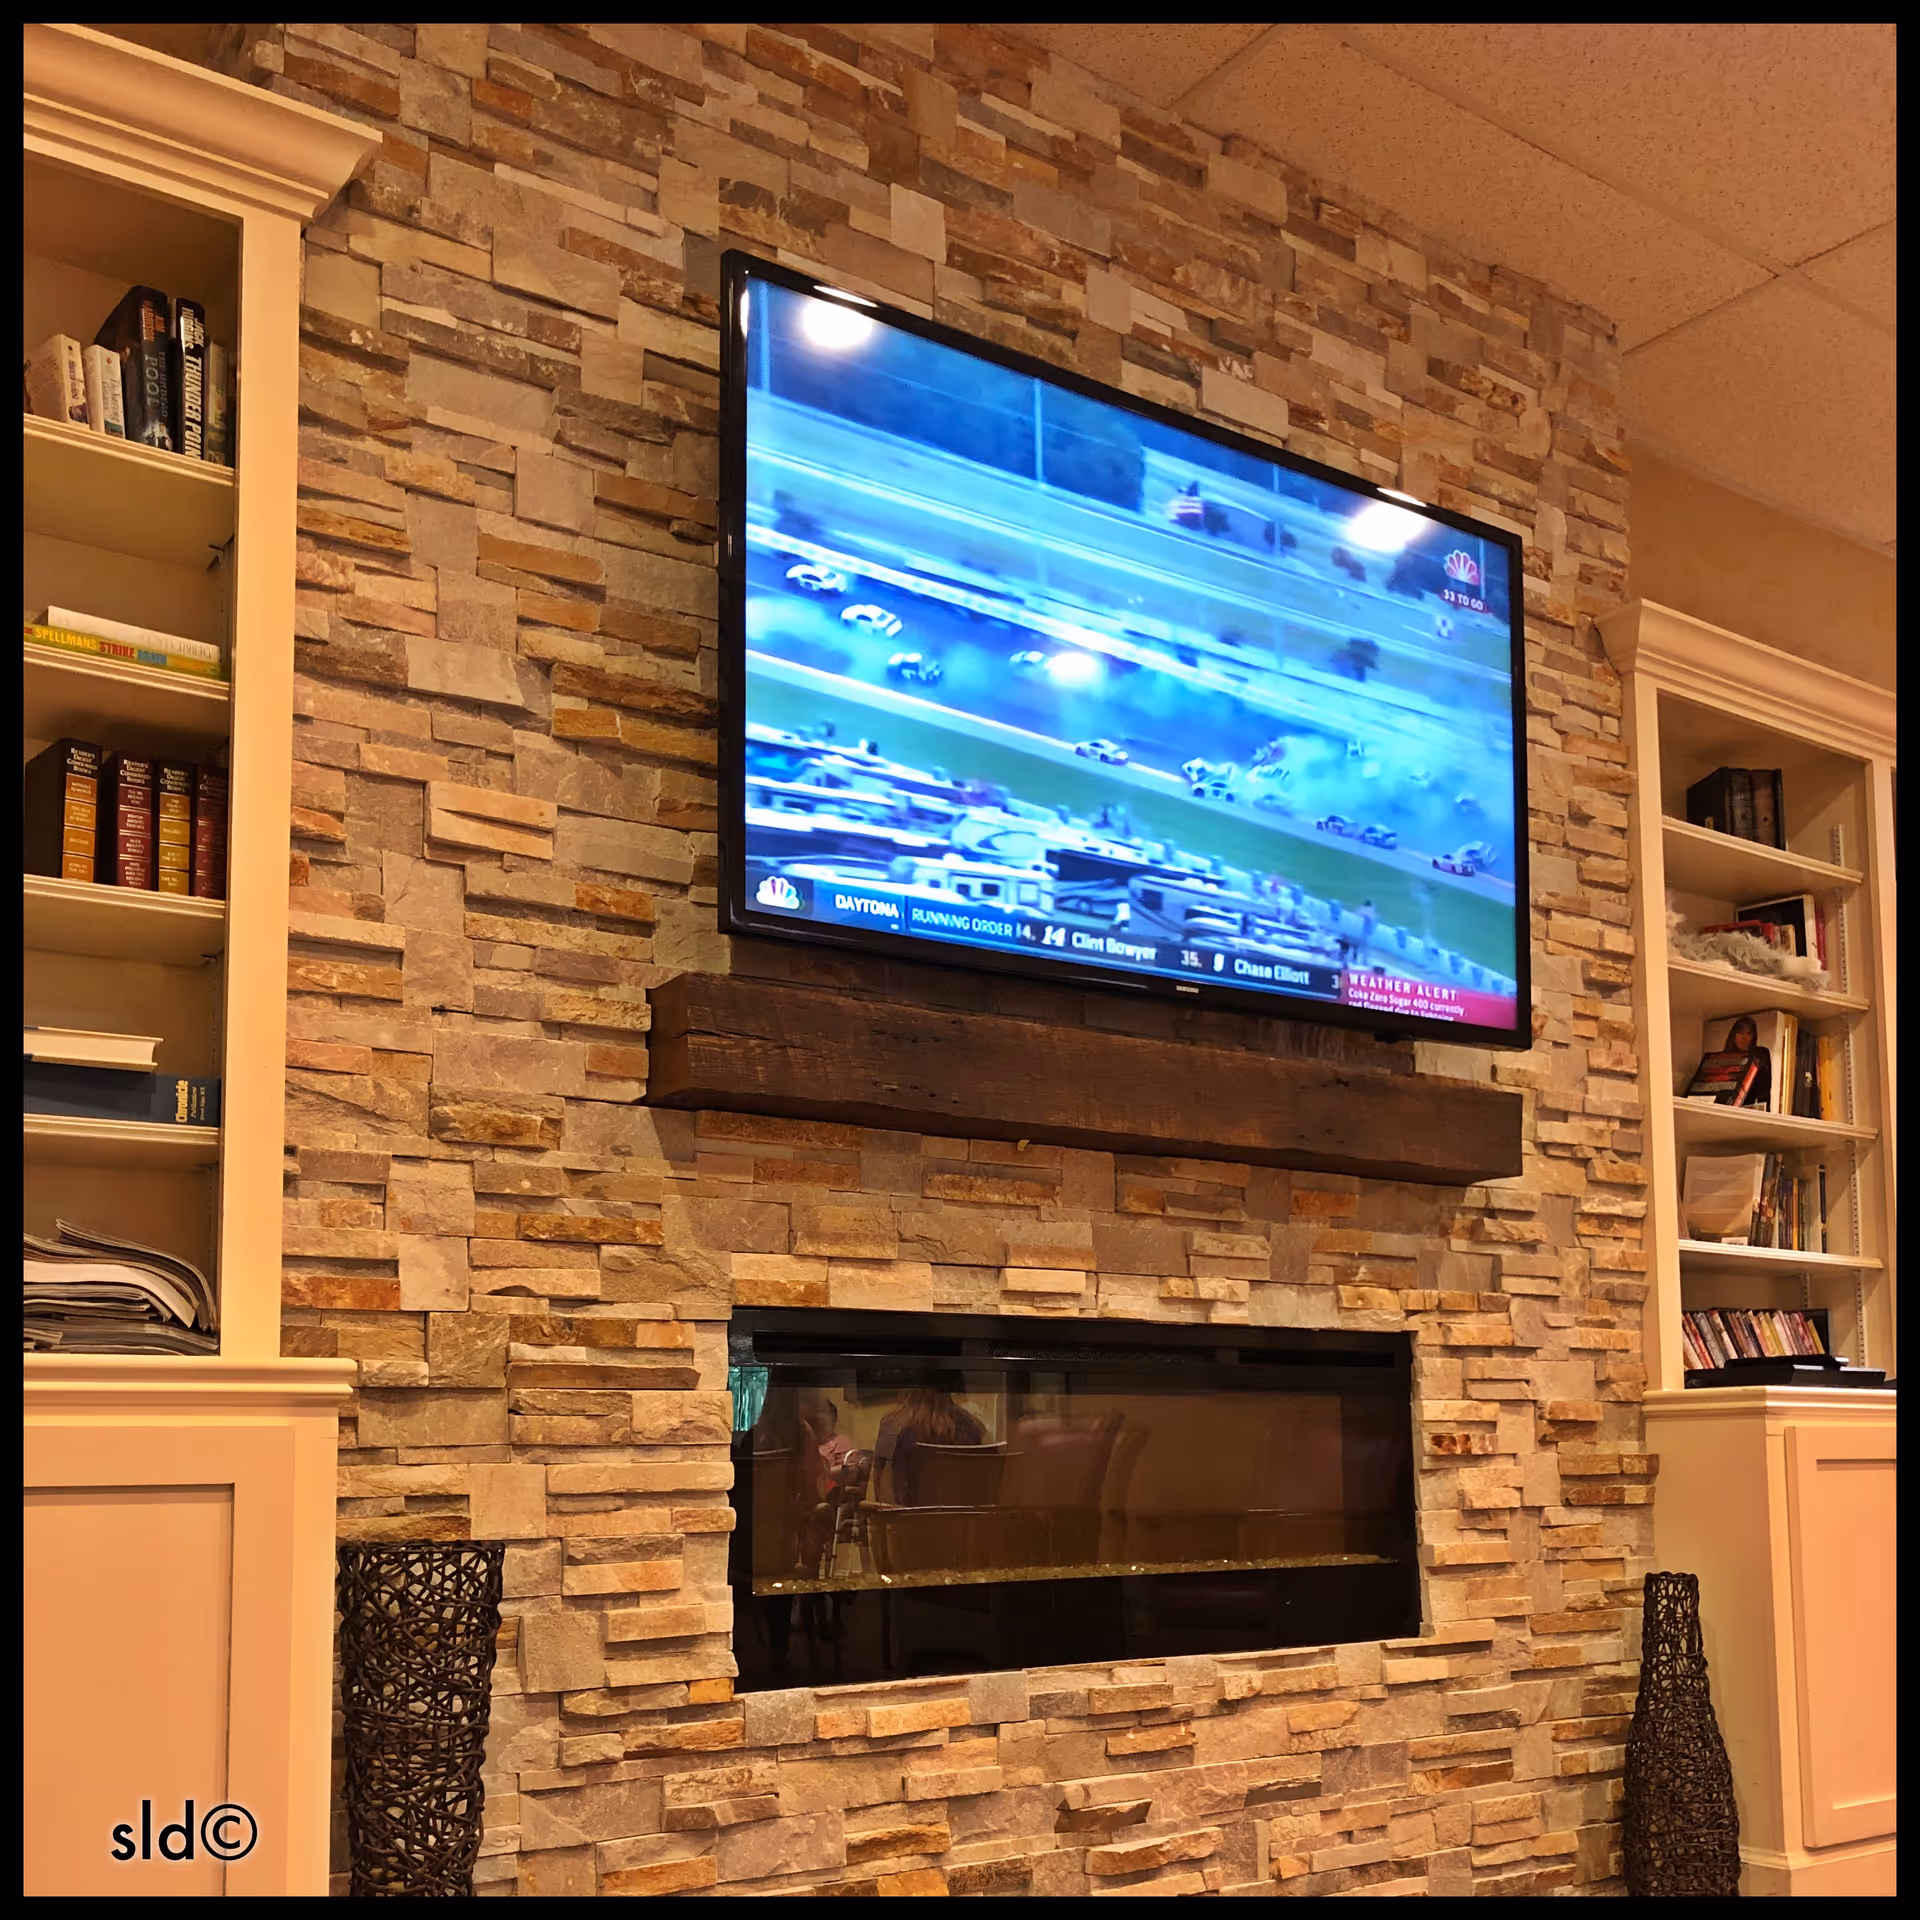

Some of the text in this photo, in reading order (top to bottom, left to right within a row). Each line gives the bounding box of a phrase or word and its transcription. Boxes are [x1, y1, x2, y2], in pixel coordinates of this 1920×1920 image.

[181, 306, 194, 349] HIGGINS
[193, 317, 204, 347] JACK
[145, 353, 159, 407] POOL
[184, 355, 202, 459] THUNDER POIN
[1444, 589, 1484, 611] 33 TO GO
[34, 626, 97, 651] SPELLMANS
[835, 893, 900, 919] DAYTONA
[912, 908, 1013, 937] RUNNING ORDER
[1041, 925, 1066, 947] 14
[1072, 931, 1104, 952] Clint
[1106, 937, 1158, 961] Bowyer
[1234, 958, 1273, 979] Chase
[1274, 964, 1310, 985] Elliott
[1349, 973, 1457, 1001] WEATHER ALERT
[1388, 994, 1412, 1008] Sugar
[175, 1079, 189, 1123] Chronicle
